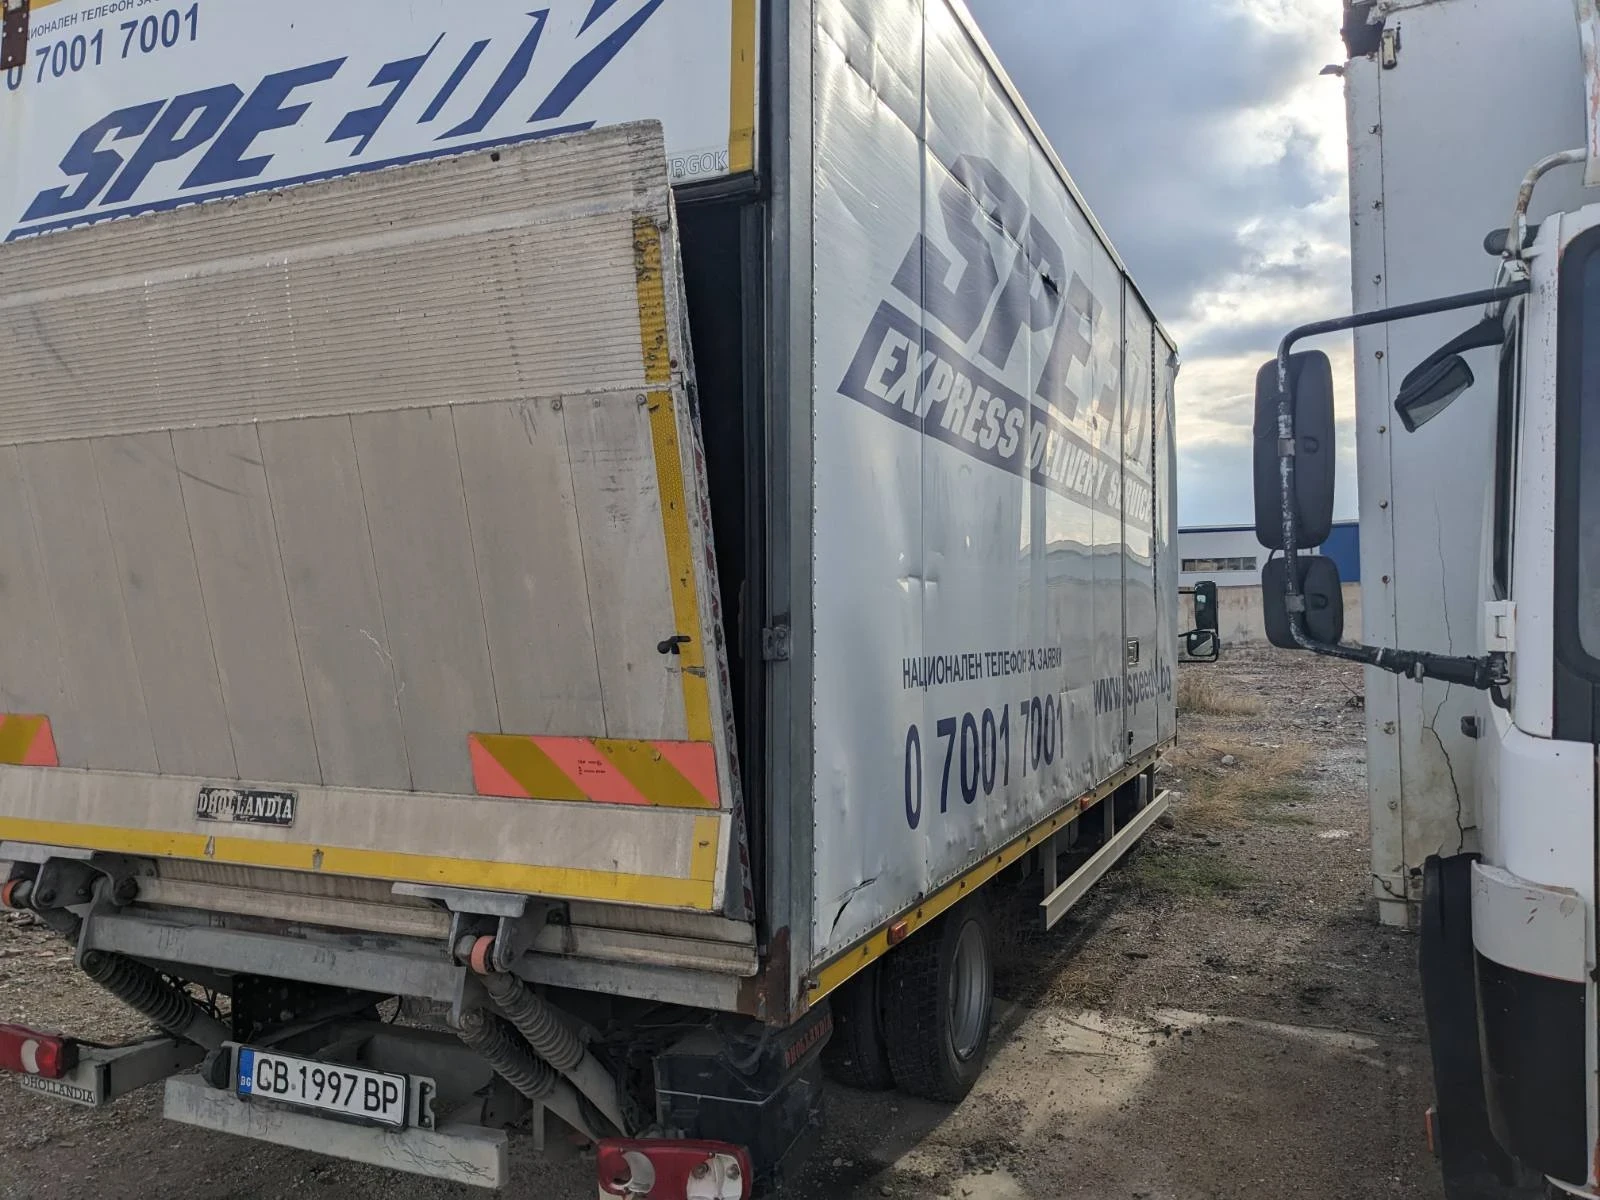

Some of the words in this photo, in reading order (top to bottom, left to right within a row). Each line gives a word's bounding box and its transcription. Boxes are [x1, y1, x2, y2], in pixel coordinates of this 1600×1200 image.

[28, 13, 78, 41] ИОНАЛЕН
[81, 0, 134, 23] ТЕЛЕФОН
[35, 28, 104, 84] 7001
[120, 2, 199, 59] 7001
[863, 326, 1025, 459] EXPRESS
[1025, 420, 1109, 500] DELIVERY
[902, 653, 983, 692] НАЦИОНАЛЕН
[984, 649, 1027, 677] ТЕЛЕФОН
[904, 723, 922, 830] 0
[936, 703, 1010, 814] 7001
[1020, 693, 1064, 778] 7001
[197, 793, 292, 819] DHOLLANDIA
[23, 1073, 95, 1104] DHOLLANDIA
[240, 1075, 251, 1087] BG
[299, 1066, 358, 1106] 1997
[364, 1077, 398, 1114] BP
